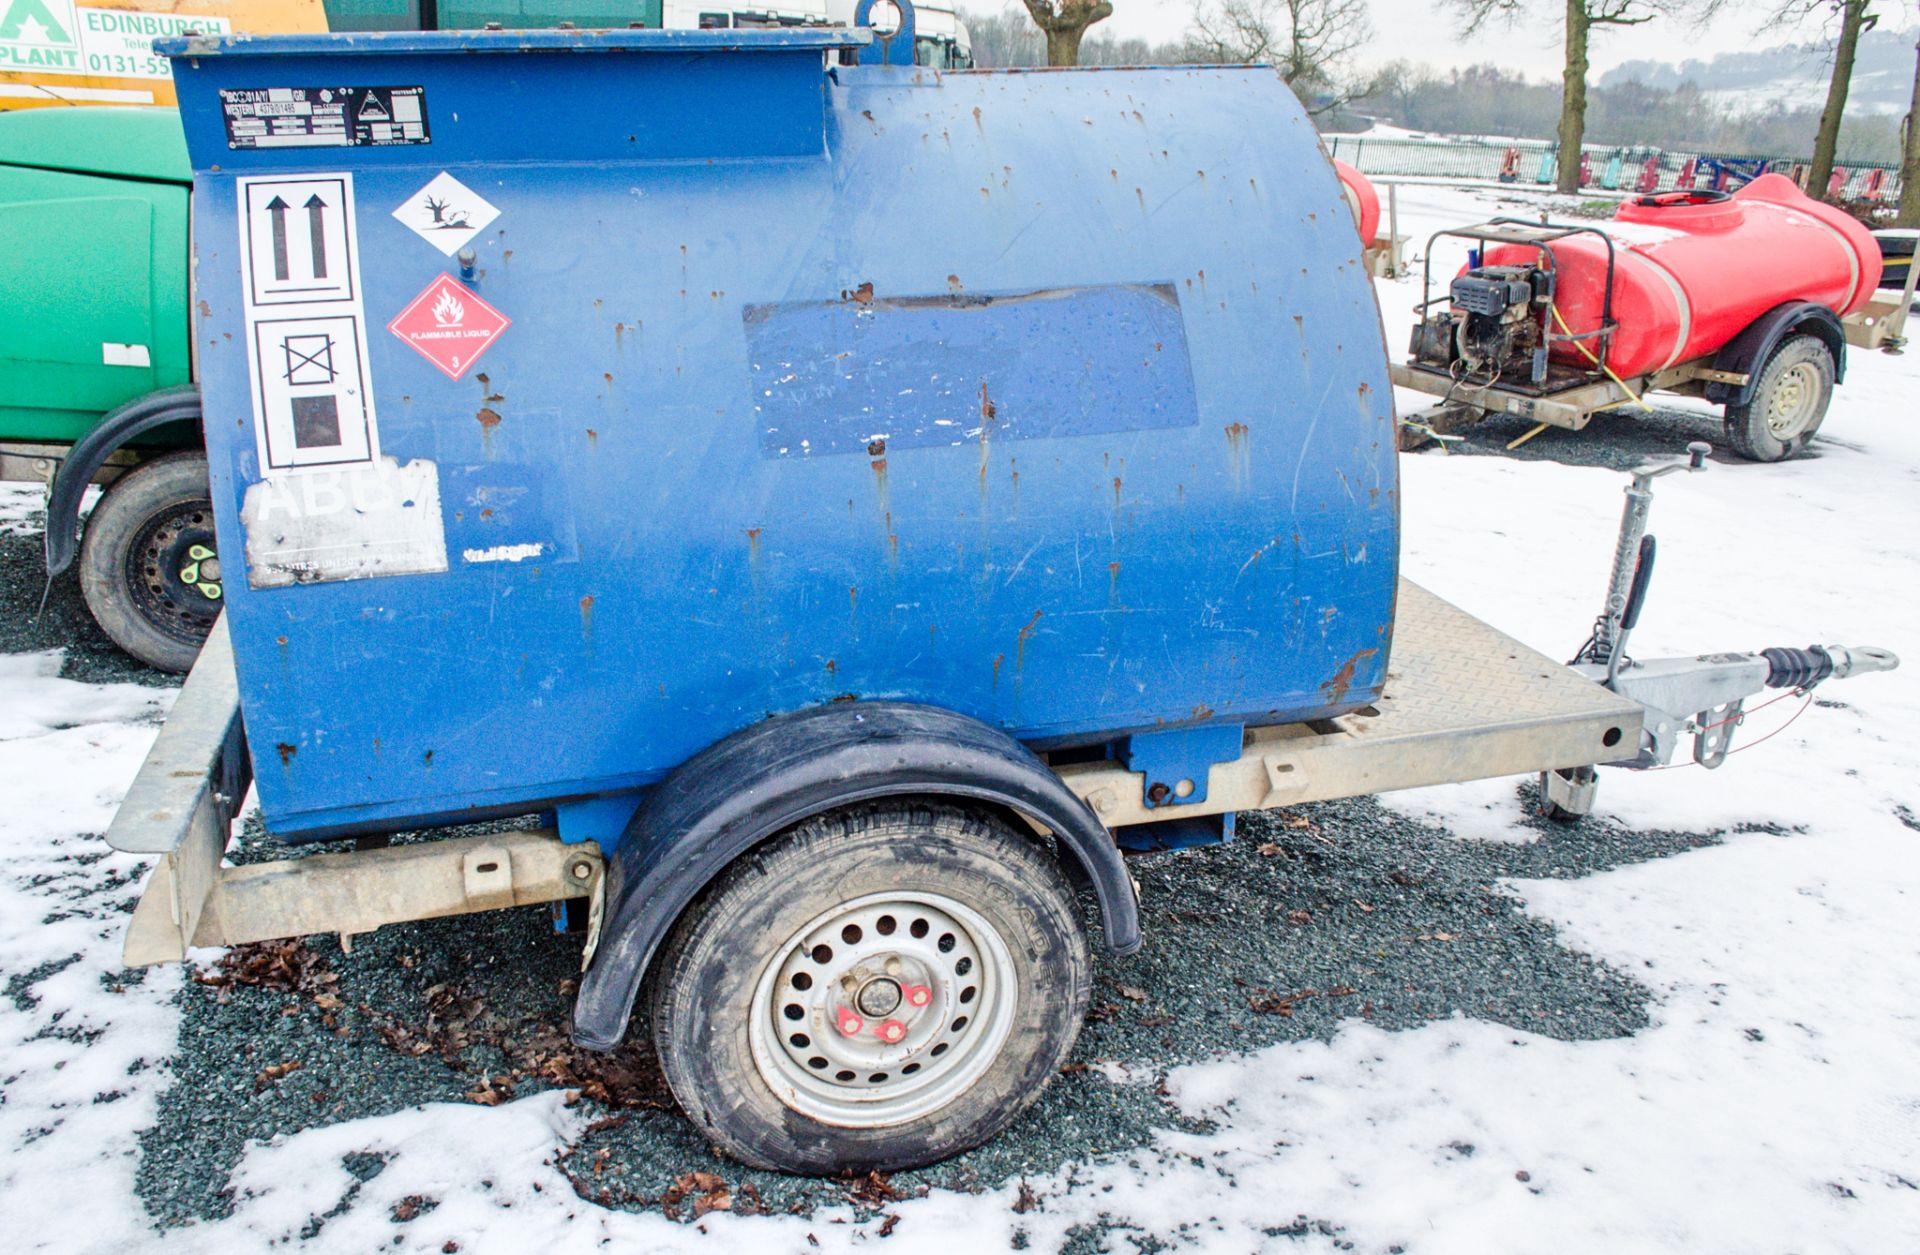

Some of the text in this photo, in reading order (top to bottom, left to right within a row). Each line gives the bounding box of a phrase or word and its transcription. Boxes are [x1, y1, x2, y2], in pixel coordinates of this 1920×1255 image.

[87, 13, 221, 36] EDINBURGH
[121, 38, 150, 49] Tele
[0, 46, 79, 67] PLANT
[410, 329, 491, 340] FLAMMABLE LIQUID
[451, 356, 460, 368] 3
